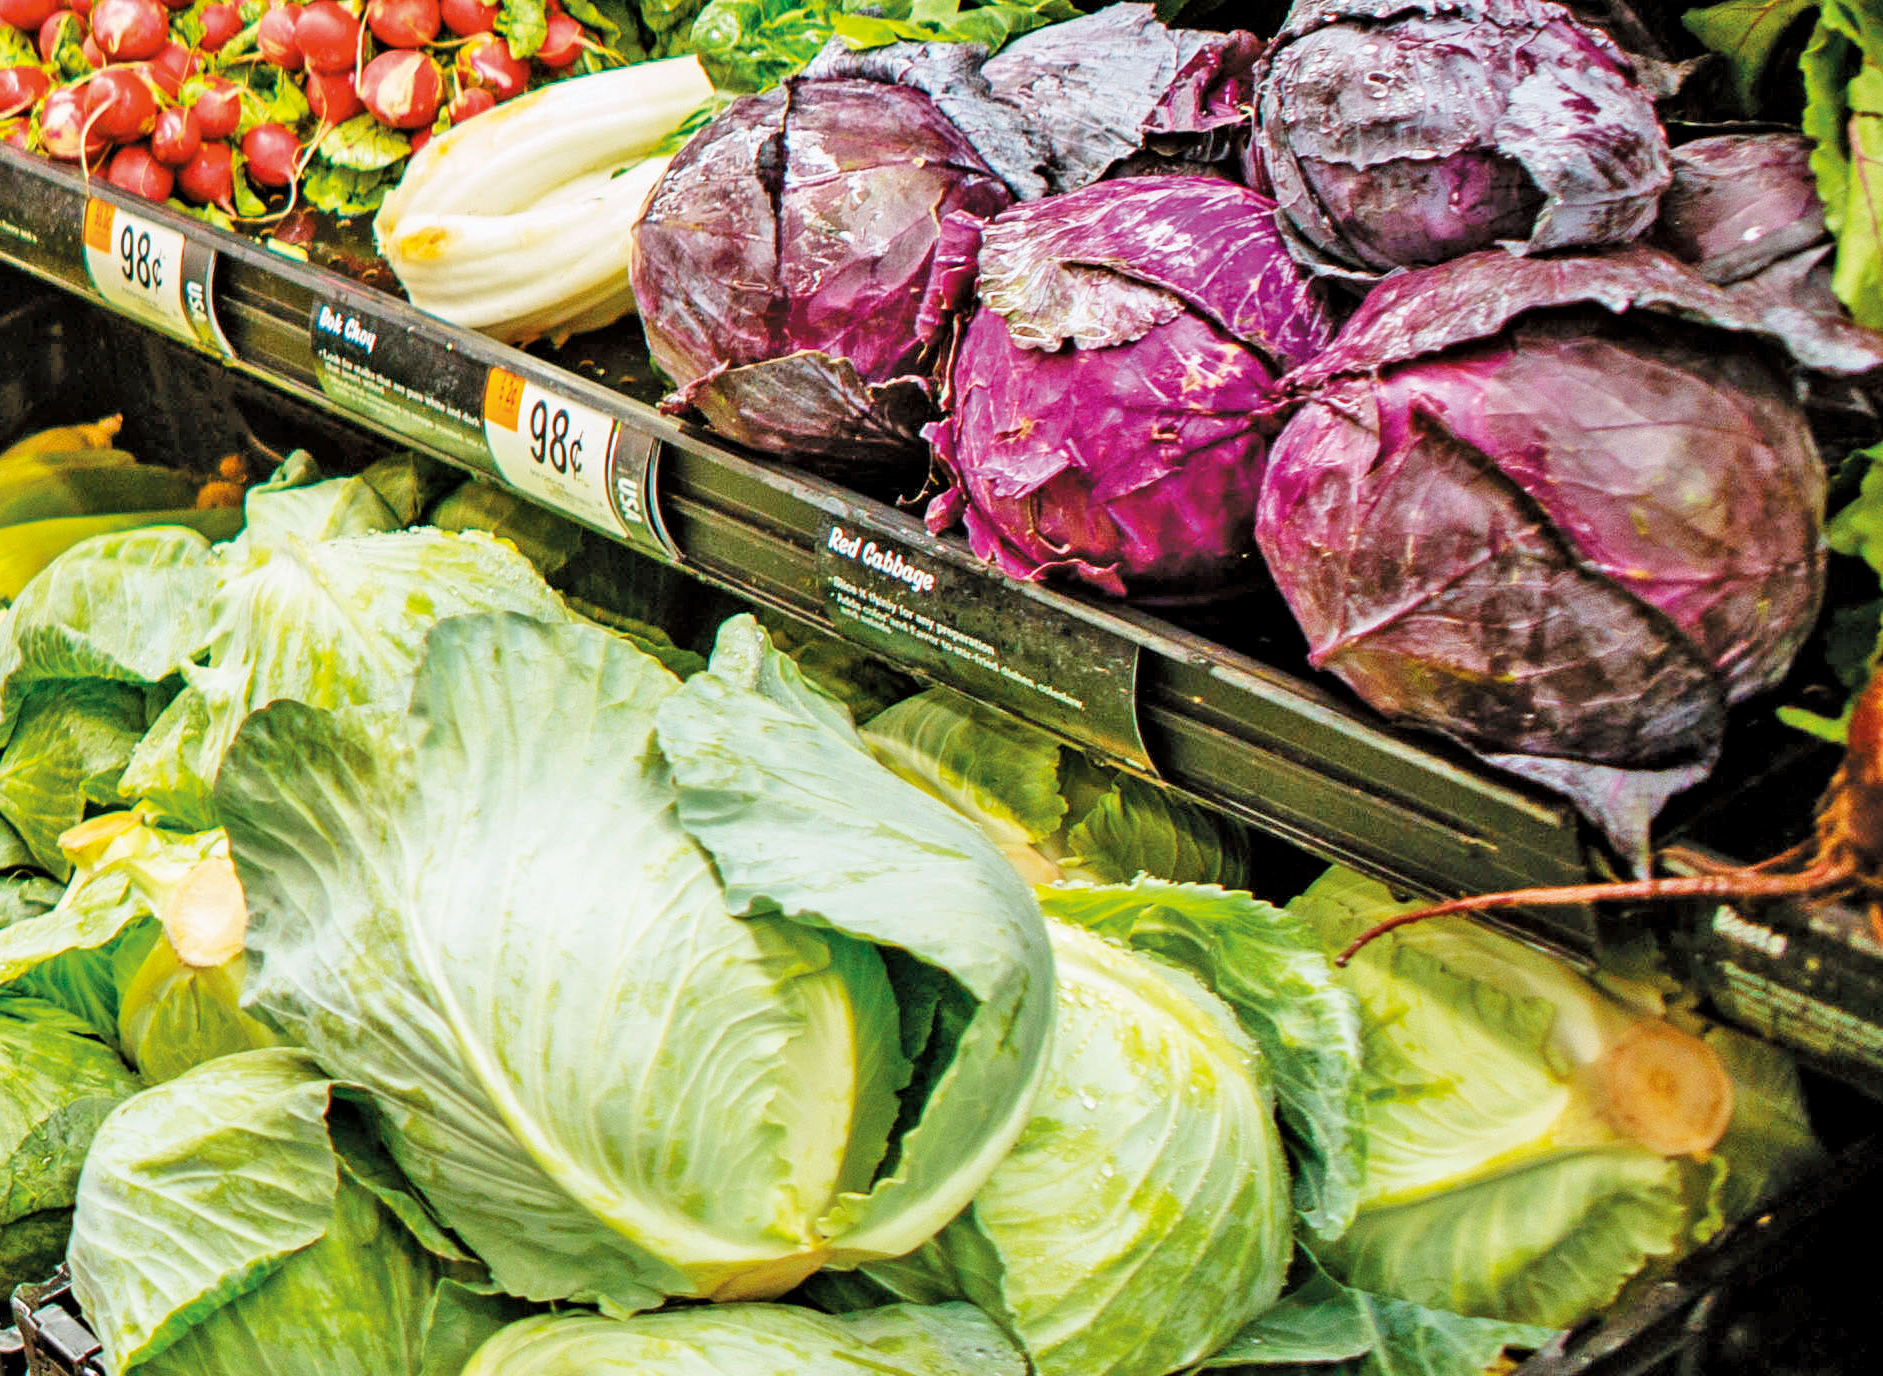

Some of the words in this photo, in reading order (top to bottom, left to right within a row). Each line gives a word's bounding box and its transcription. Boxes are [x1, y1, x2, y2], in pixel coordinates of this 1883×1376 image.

[120, 224, 163, 297] 98¢
[186, 279, 208, 322] USA
[317, 304, 344, 336] Bok
[343, 316, 378, 357] Choy
[529, 398, 585, 481] 98¢
[617, 476, 643, 523] USA
[826, 526, 863, 560] Red
[862, 539, 936, 592] Cabbage
